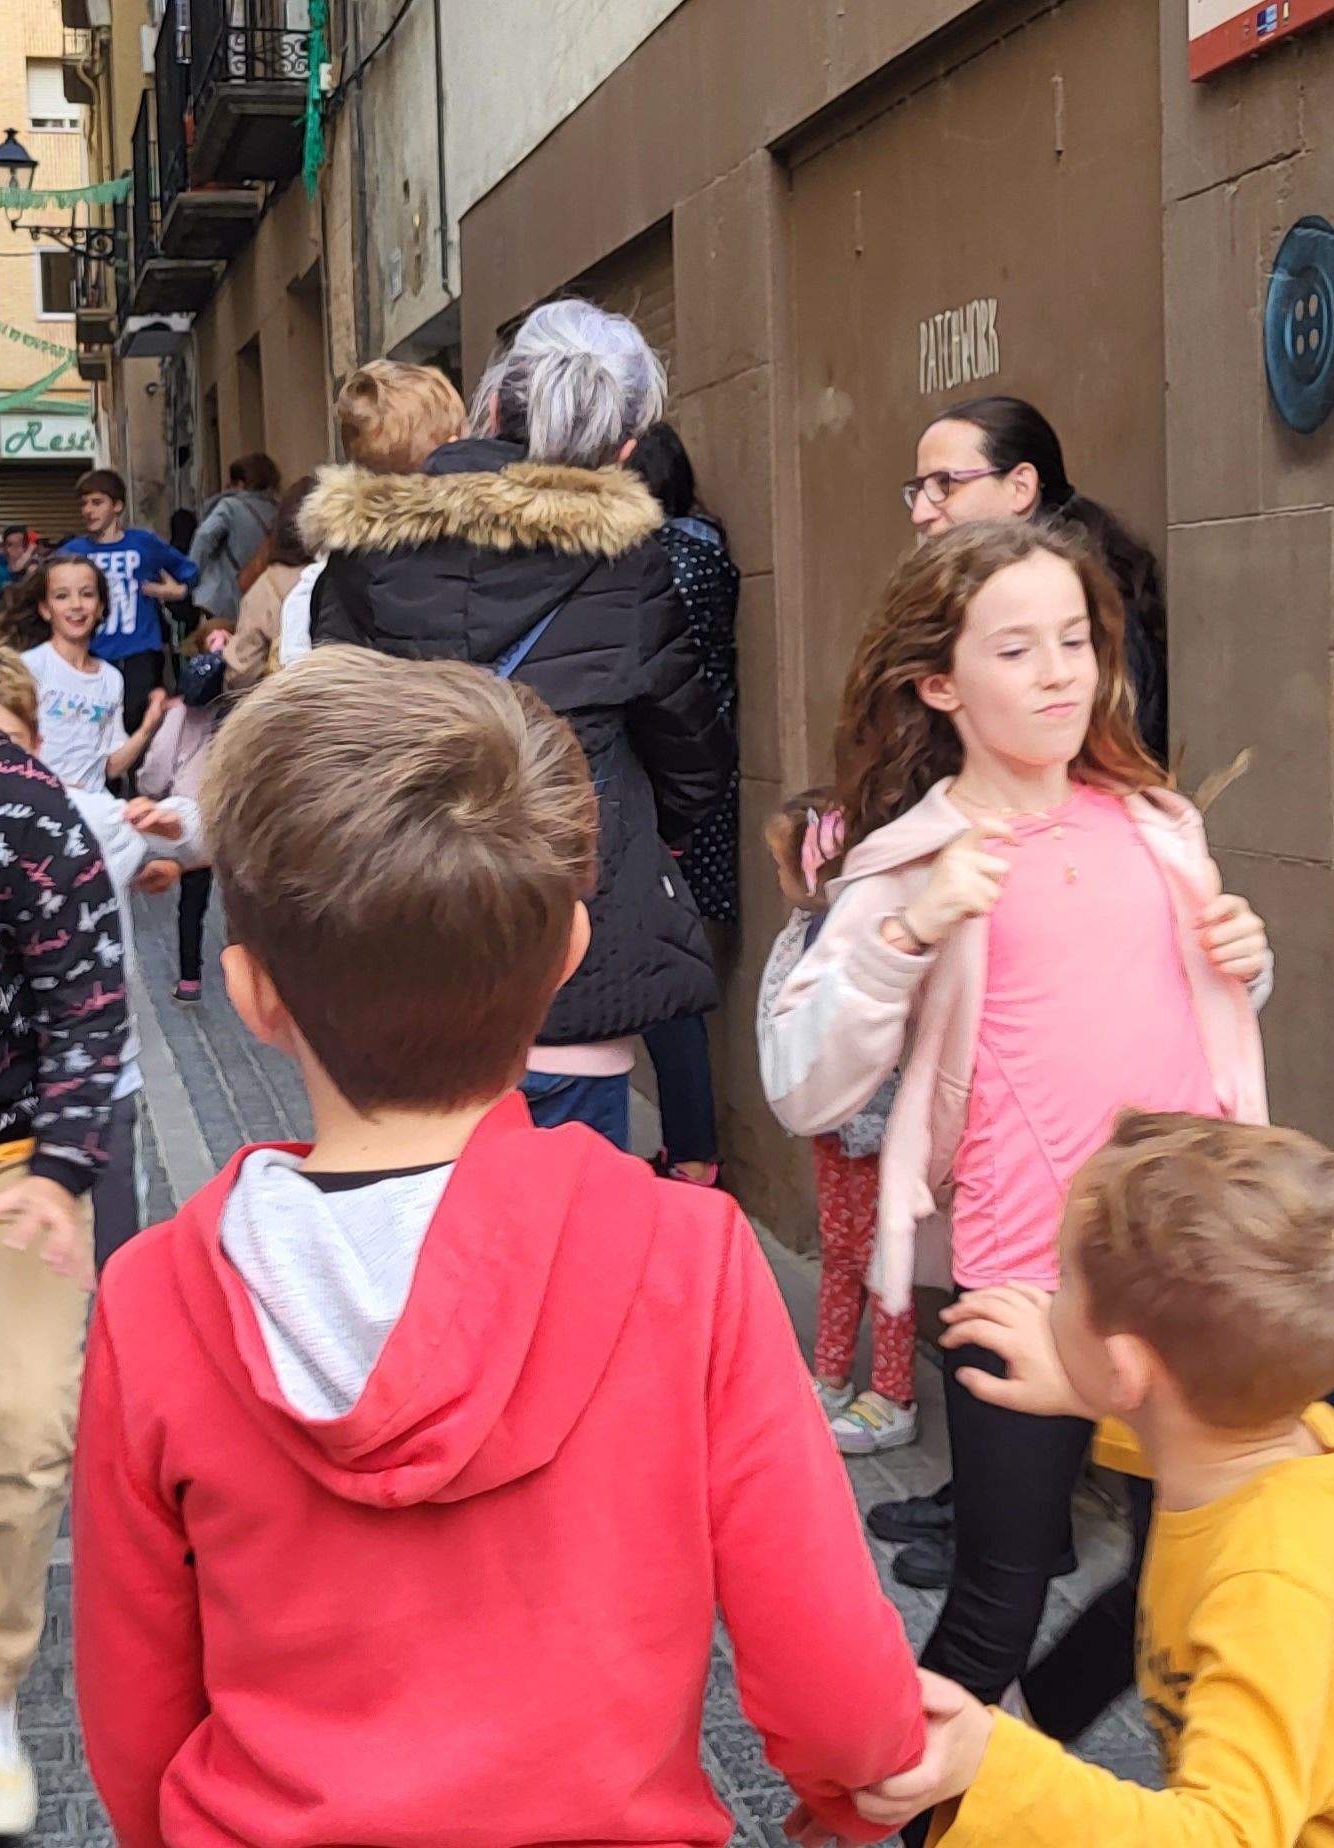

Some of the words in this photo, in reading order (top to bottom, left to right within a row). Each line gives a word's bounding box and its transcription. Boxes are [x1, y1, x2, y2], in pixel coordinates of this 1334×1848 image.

[919, 298, 1000, 394] PATCHWORK
[4, 420, 96, 454] Rest
[87, 549, 142, 582] EEP
